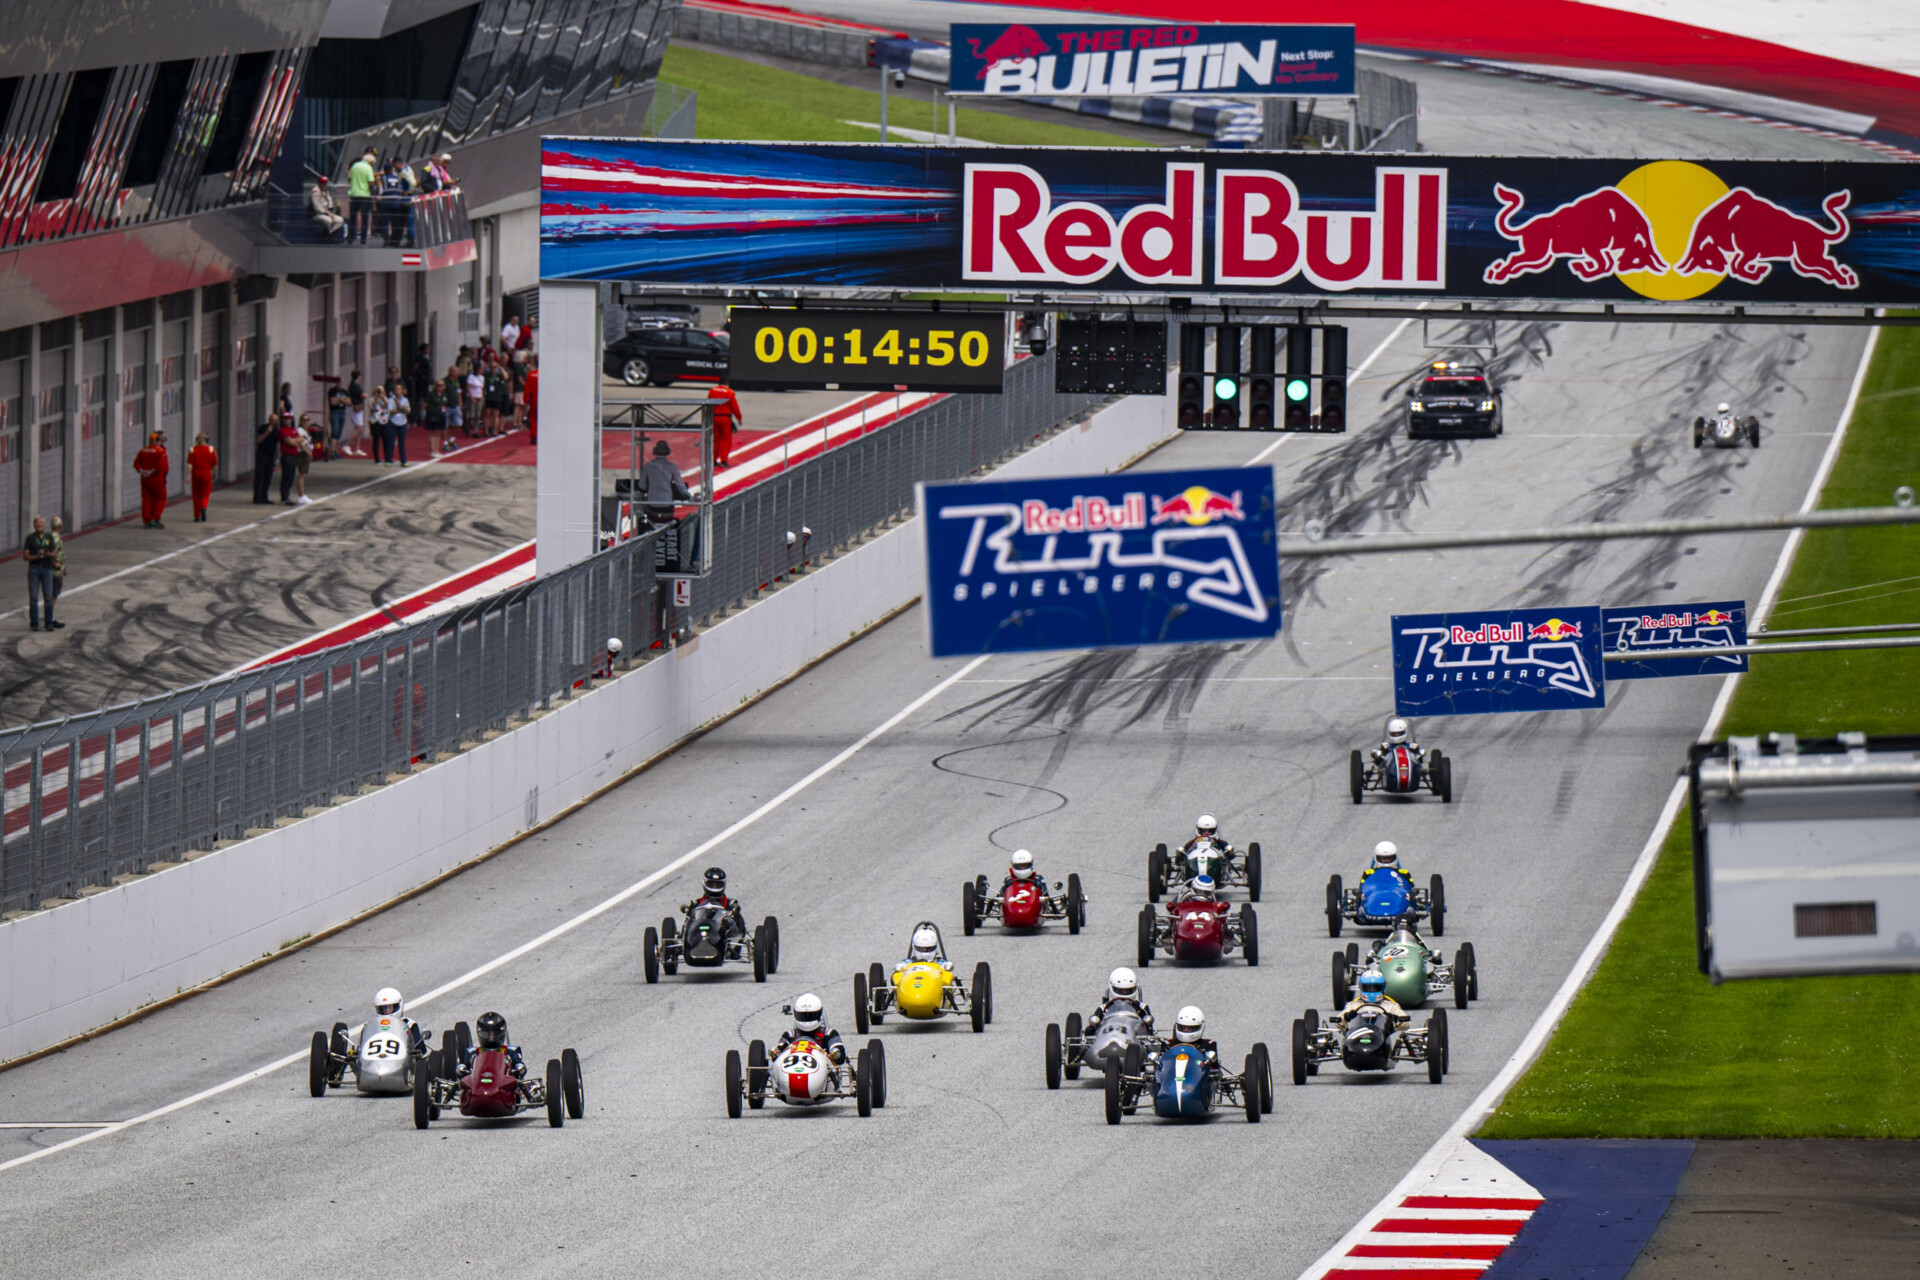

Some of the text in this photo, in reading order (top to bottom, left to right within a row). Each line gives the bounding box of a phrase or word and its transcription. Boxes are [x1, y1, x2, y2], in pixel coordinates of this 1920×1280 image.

[1057, 25, 1198, 54] THE RED
[1281, 49, 1335, 61] Next Stop:
[963, 162, 1447, 291] Red Bull
[755, 327, 989, 367] 00:14:50
[686, 360, 728, 369] MEDICAL CAR
[1023, 492, 1147, 535] Red Bull
[953, 572, 1183, 601] SPIELBERG
[1641, 612, 1692, 629] Red Bull
[1451, 621, 1523, 645] Red Bull
[1409, 668, 1545, 683] SPIELBERG
[1185, 911, 1212, 921] 44
[368, 1039, 400, 1056] 59
[783, 1055, 818, 1069] 99
